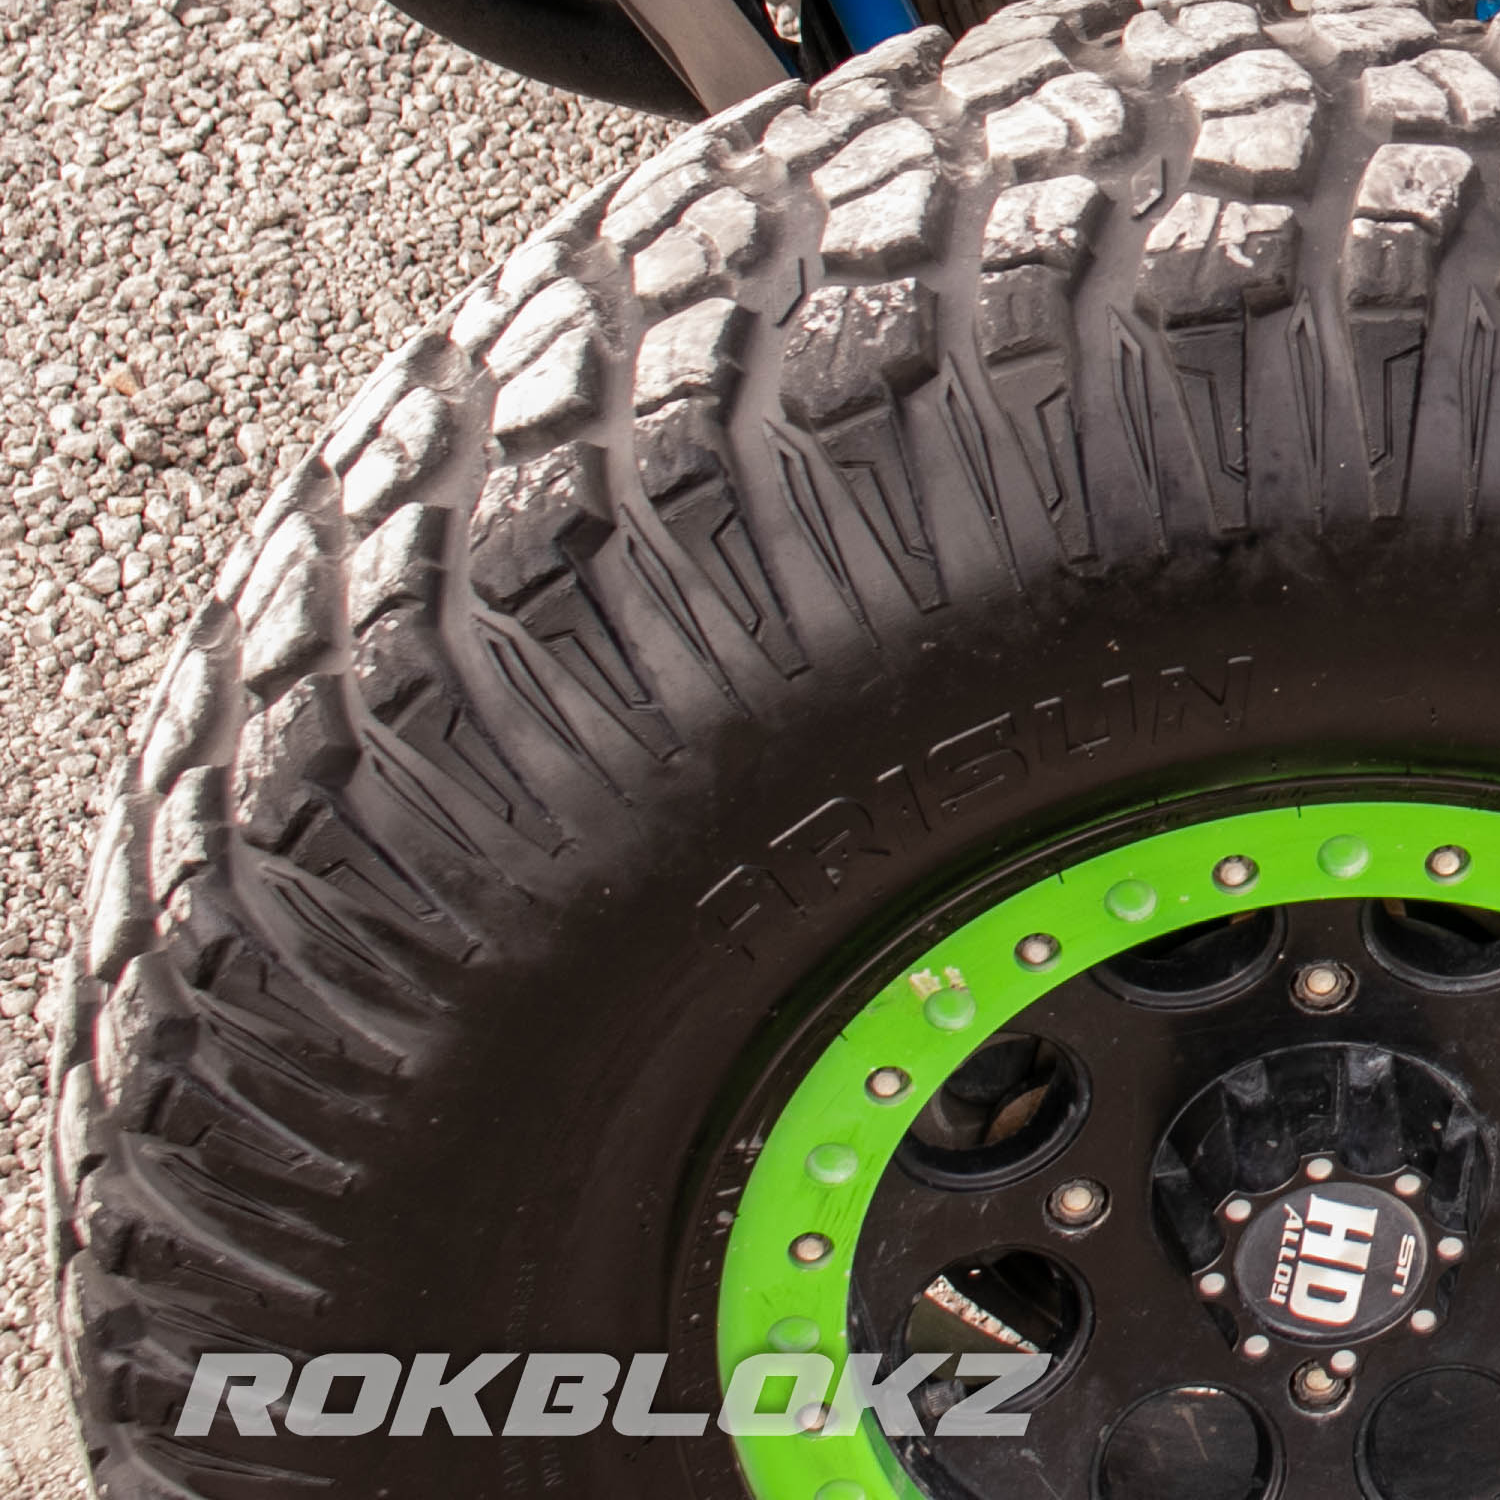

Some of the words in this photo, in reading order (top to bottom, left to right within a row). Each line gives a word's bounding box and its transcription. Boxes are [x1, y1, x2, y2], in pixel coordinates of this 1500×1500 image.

[697, 655, 1254, 961] ARISUN
[1269, 1203, 1305, 1306] ALLOY
[1289, 1193, 1379, 1328] HD
[1391, 1234, 1416, 1295] STI
